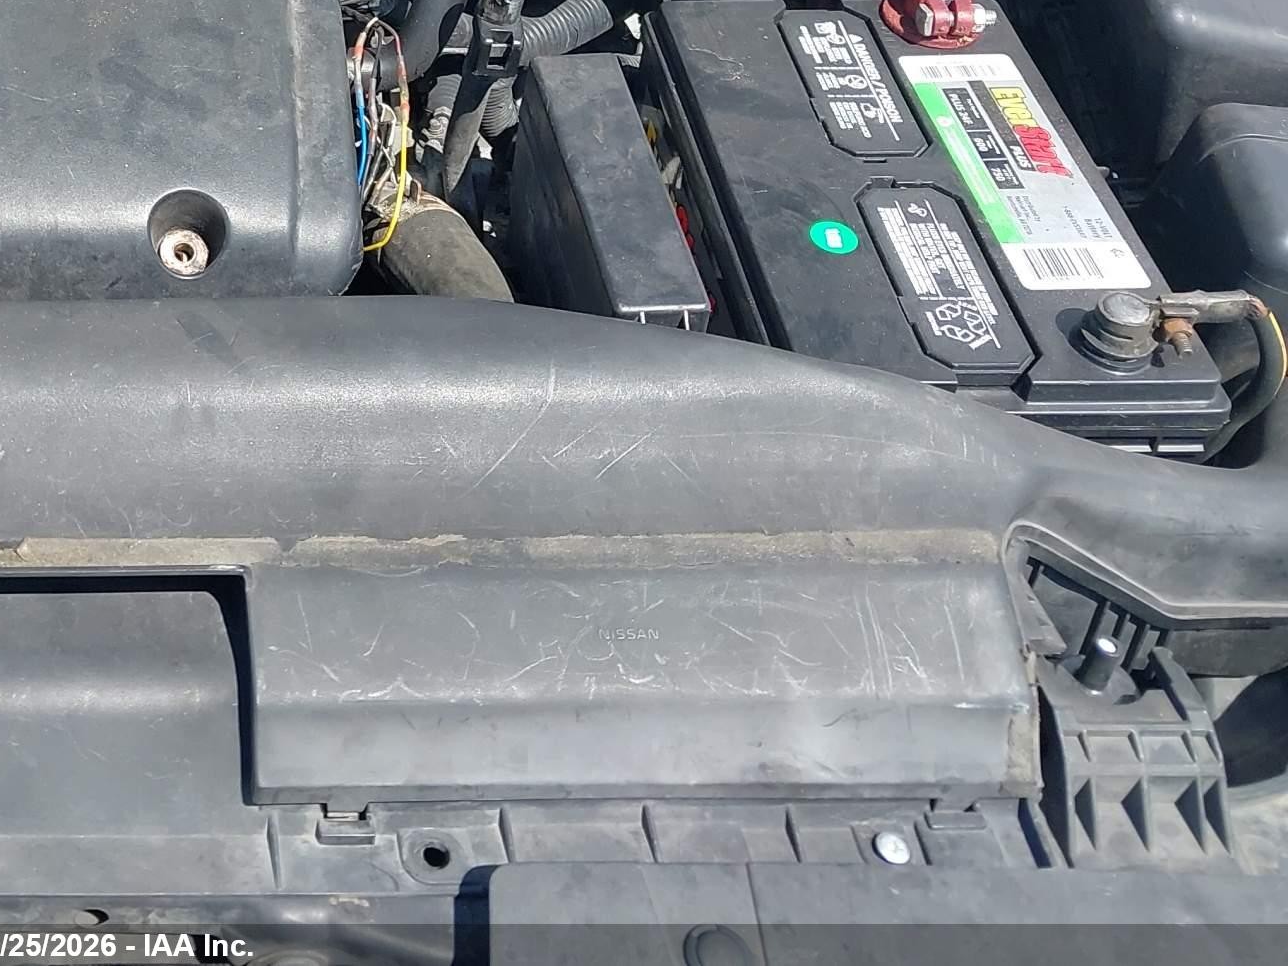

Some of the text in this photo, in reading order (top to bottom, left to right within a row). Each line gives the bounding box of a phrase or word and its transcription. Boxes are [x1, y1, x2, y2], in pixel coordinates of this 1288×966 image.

[948, 93, 965, 111] PLUS
[989, 87, 1074, 177] EverStart
[973, 137, 989, 151] 600
[1009, 145, 1032, 168] PLUS
[991, 168, 1006, 181] 750
[599, 629, 659, 640] NISSAN
